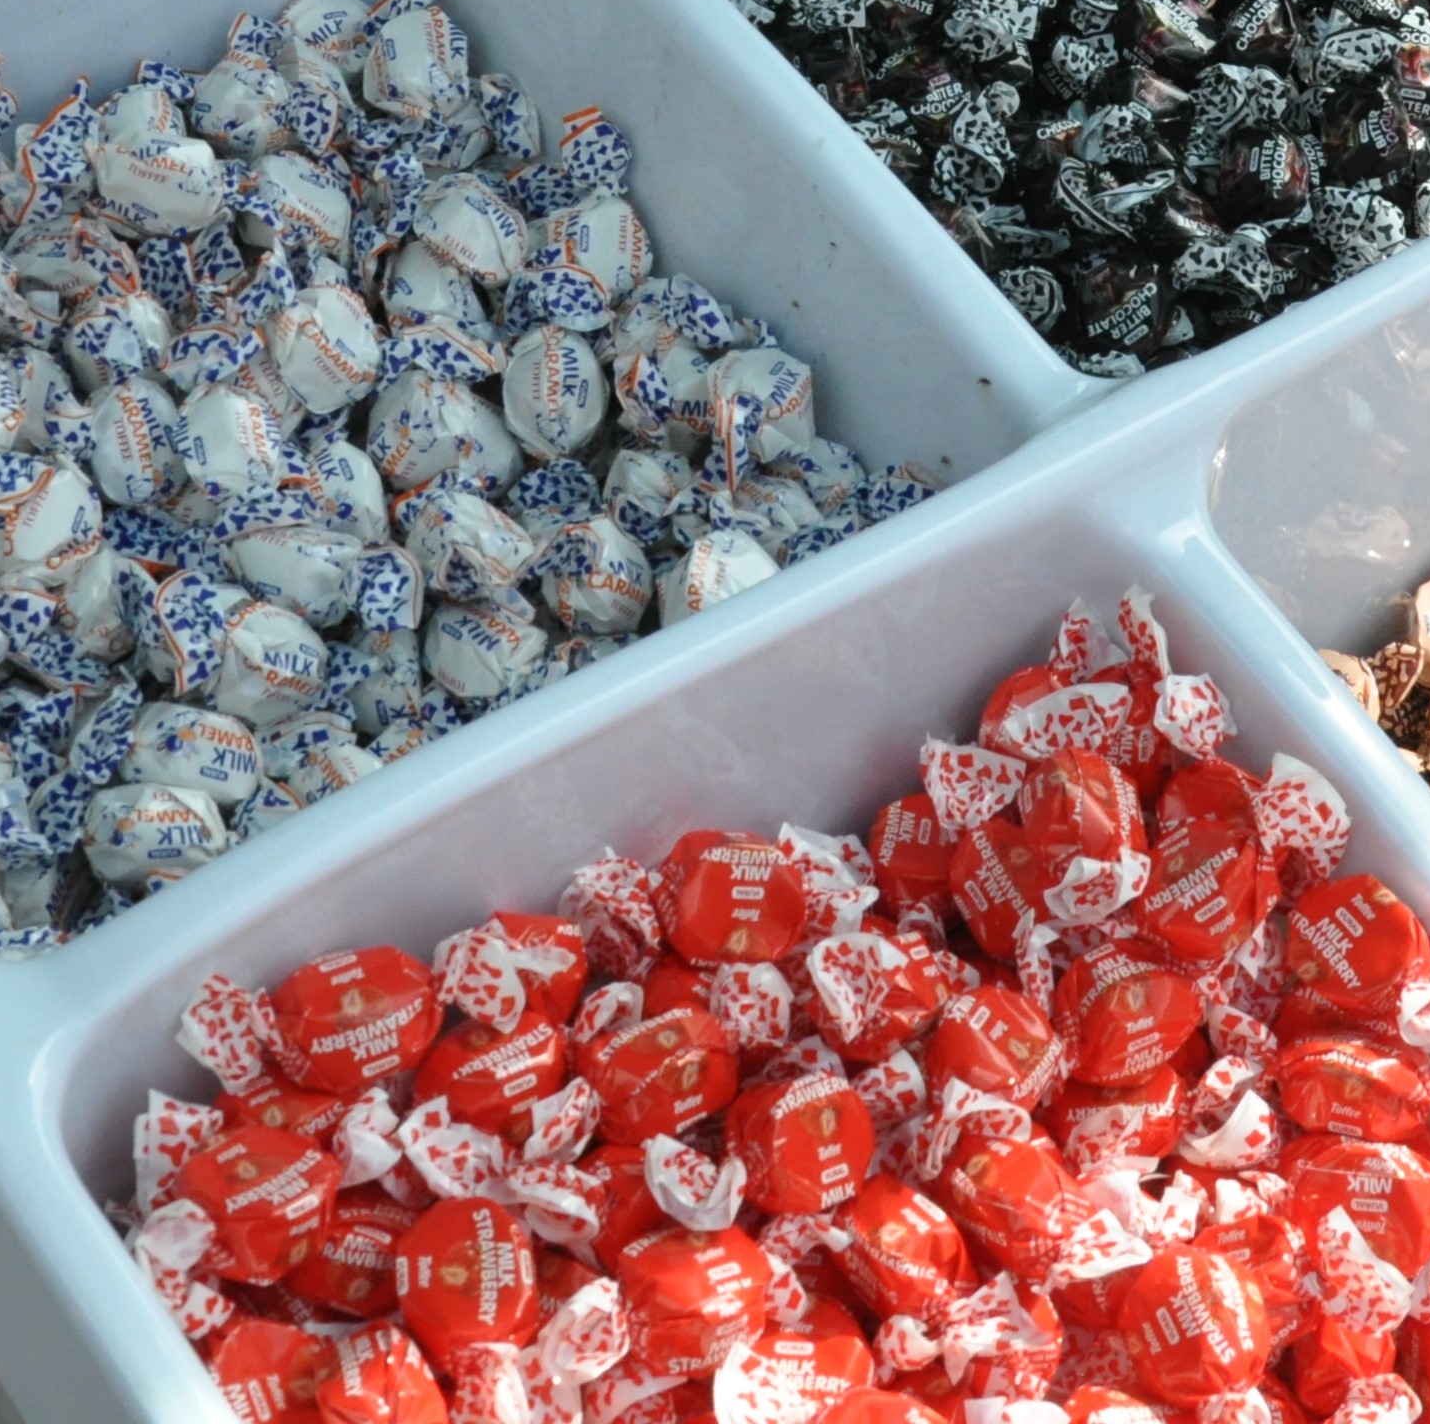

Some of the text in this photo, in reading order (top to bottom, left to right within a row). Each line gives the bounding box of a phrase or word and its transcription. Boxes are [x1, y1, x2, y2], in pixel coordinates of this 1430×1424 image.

[304, 19, 343, 46] MILK
[1258, 139, 1275, 181] BITTER
[618, 214, 629, 252] TOFFEE
[1109, 301, 1154, 343] BITTER
[562, 346, 575, 398] MILK
[770, 366, 801, 406] MILK
[112, 419, 133, 464] TOFFEE
[137, 396, 167, 452] MILK
[176, 415, 194, 460] MILK
[454, 614, 501, 651] MILK
[264, 649, 315, 676] MILK
[213, 747, 257, 768] MILK
[730, 863, 771, 882] MILK
[1143, 847, 1239, 914] STRAWBERRY
[732, 888, 763, 899] VURAL
[1179, 876, 1221, 911] MILK
[1349, 893, 1377, 922] Toffee
[1208, 912, 1237, 937] Toffee
[1315, 920, 1355, 953] MILK
[1337, 908, 1362, 935] VURAL
[310, 996, 425, 1056] STRAWBERRY
[1126, 1015, 1155, 1034] Toffee
[351, 1032, 399, 1063] MILK
[671, 1093, 704, 1117] Toffee
[225, 1148, 324, 1215] STRAWBERRY
[266, 1176, 310, 1210] MILK
[1347, 1175, 1394, 1195] MILK
[416, 1254, 432, 1290] Toffee
[472, 1206, 498, 1328] STRAWBERRY
[496, 1240, 515, 1290] MILK
[1170, 1291, 1201, 1338] MILK
[1176, 1255, 1236, 1364] STRAWBERRY
